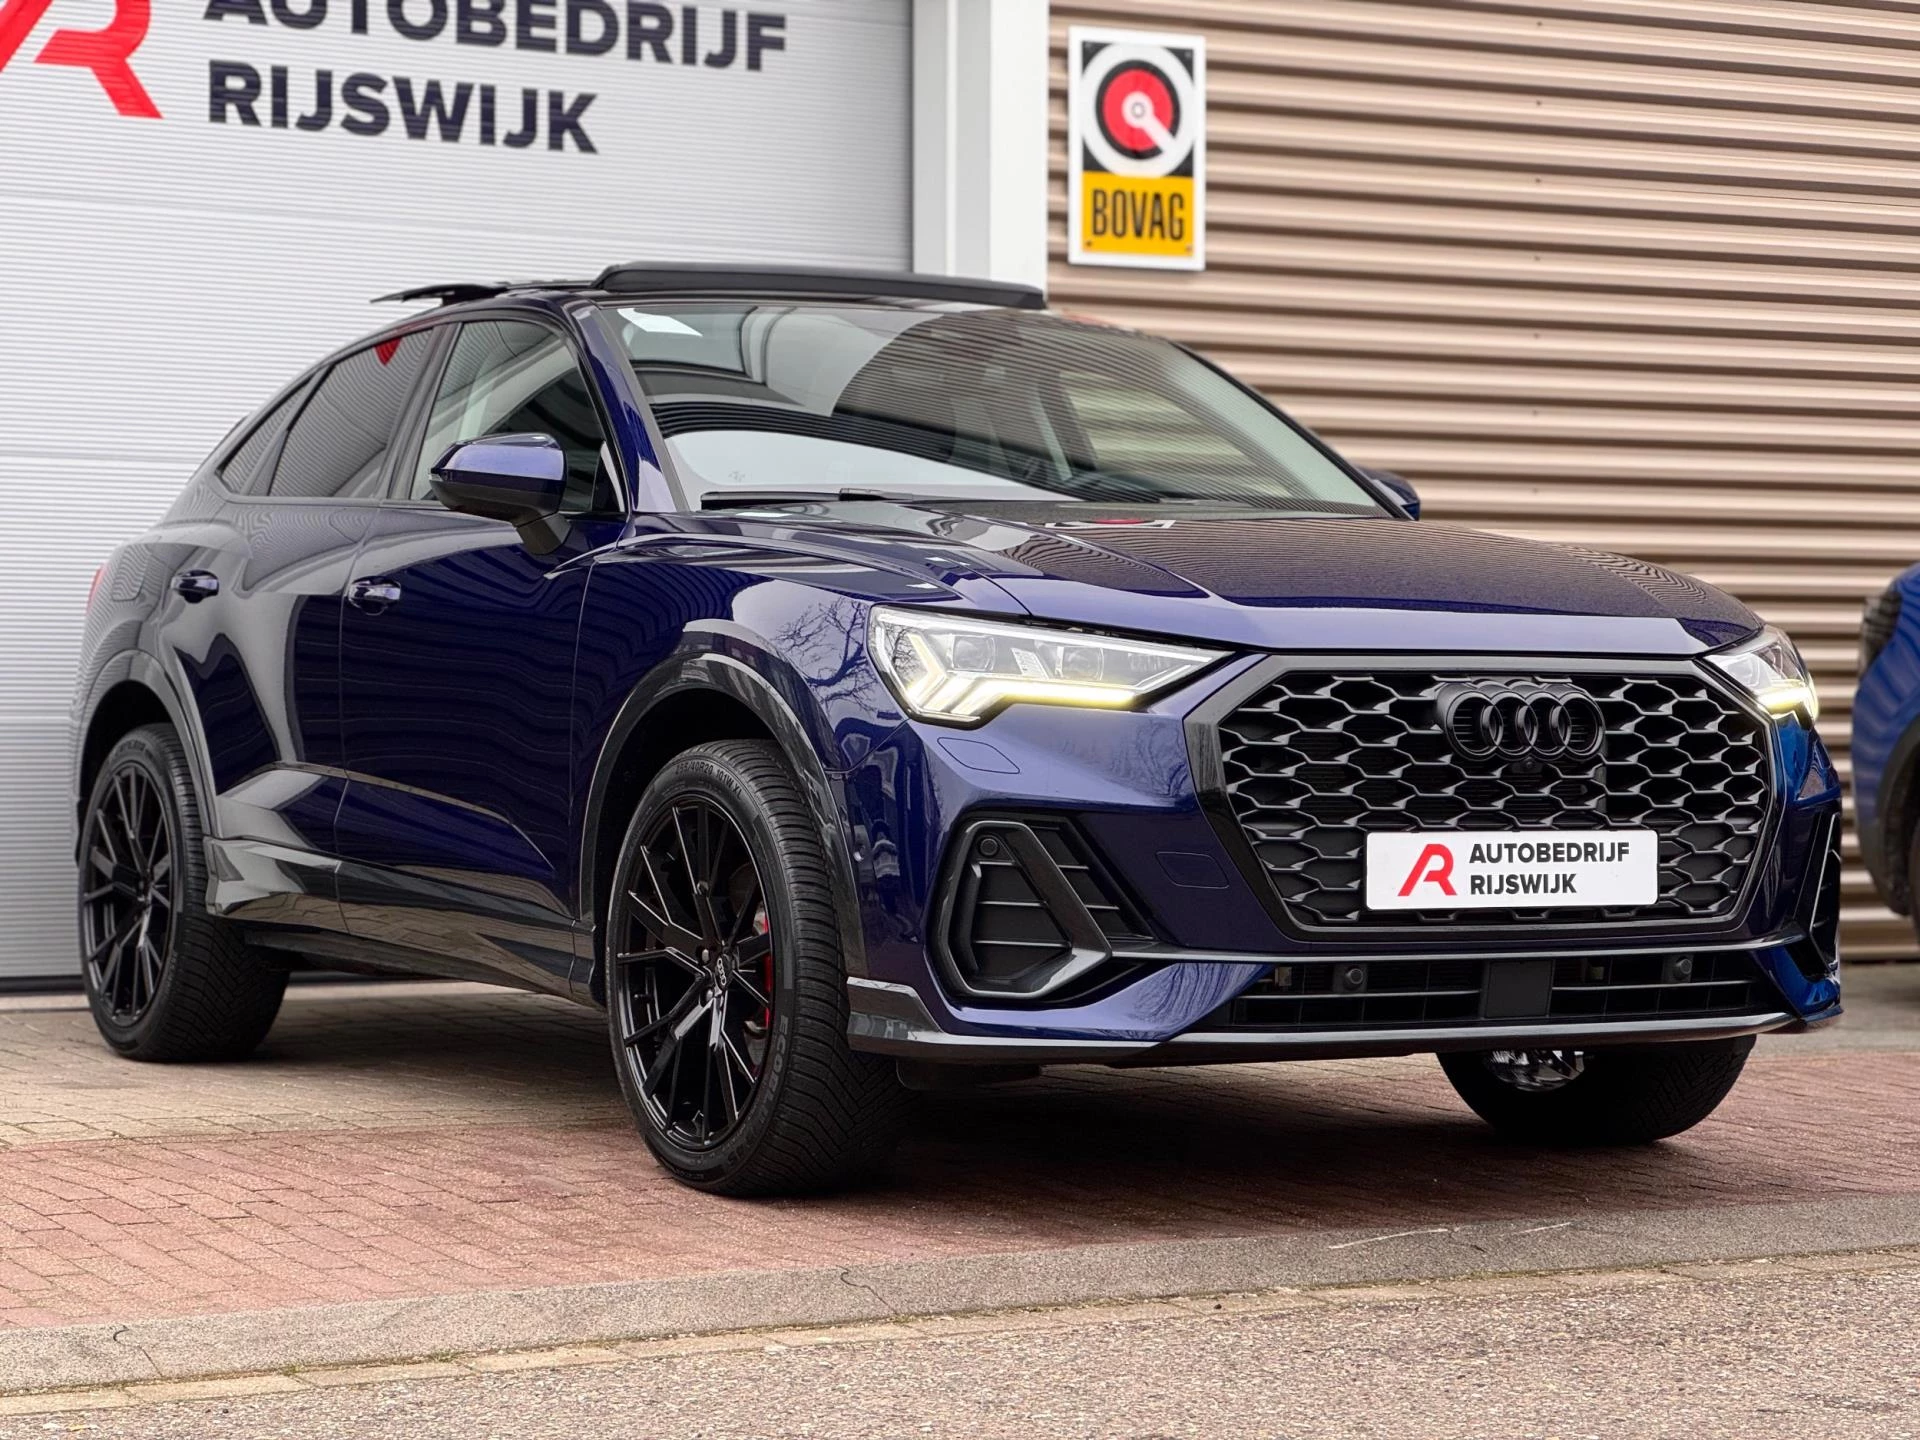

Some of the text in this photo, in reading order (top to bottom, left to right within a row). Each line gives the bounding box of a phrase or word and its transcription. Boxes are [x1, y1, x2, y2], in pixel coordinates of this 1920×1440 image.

[208, 59, 598, 154] RIJSWIJK
[1092, 189, 1185, 241] BOVAG
[1469, 842, 1630, 864] AUTOBEDRIJF
[1470, 873, 1577, 895] RIJSWIJK
